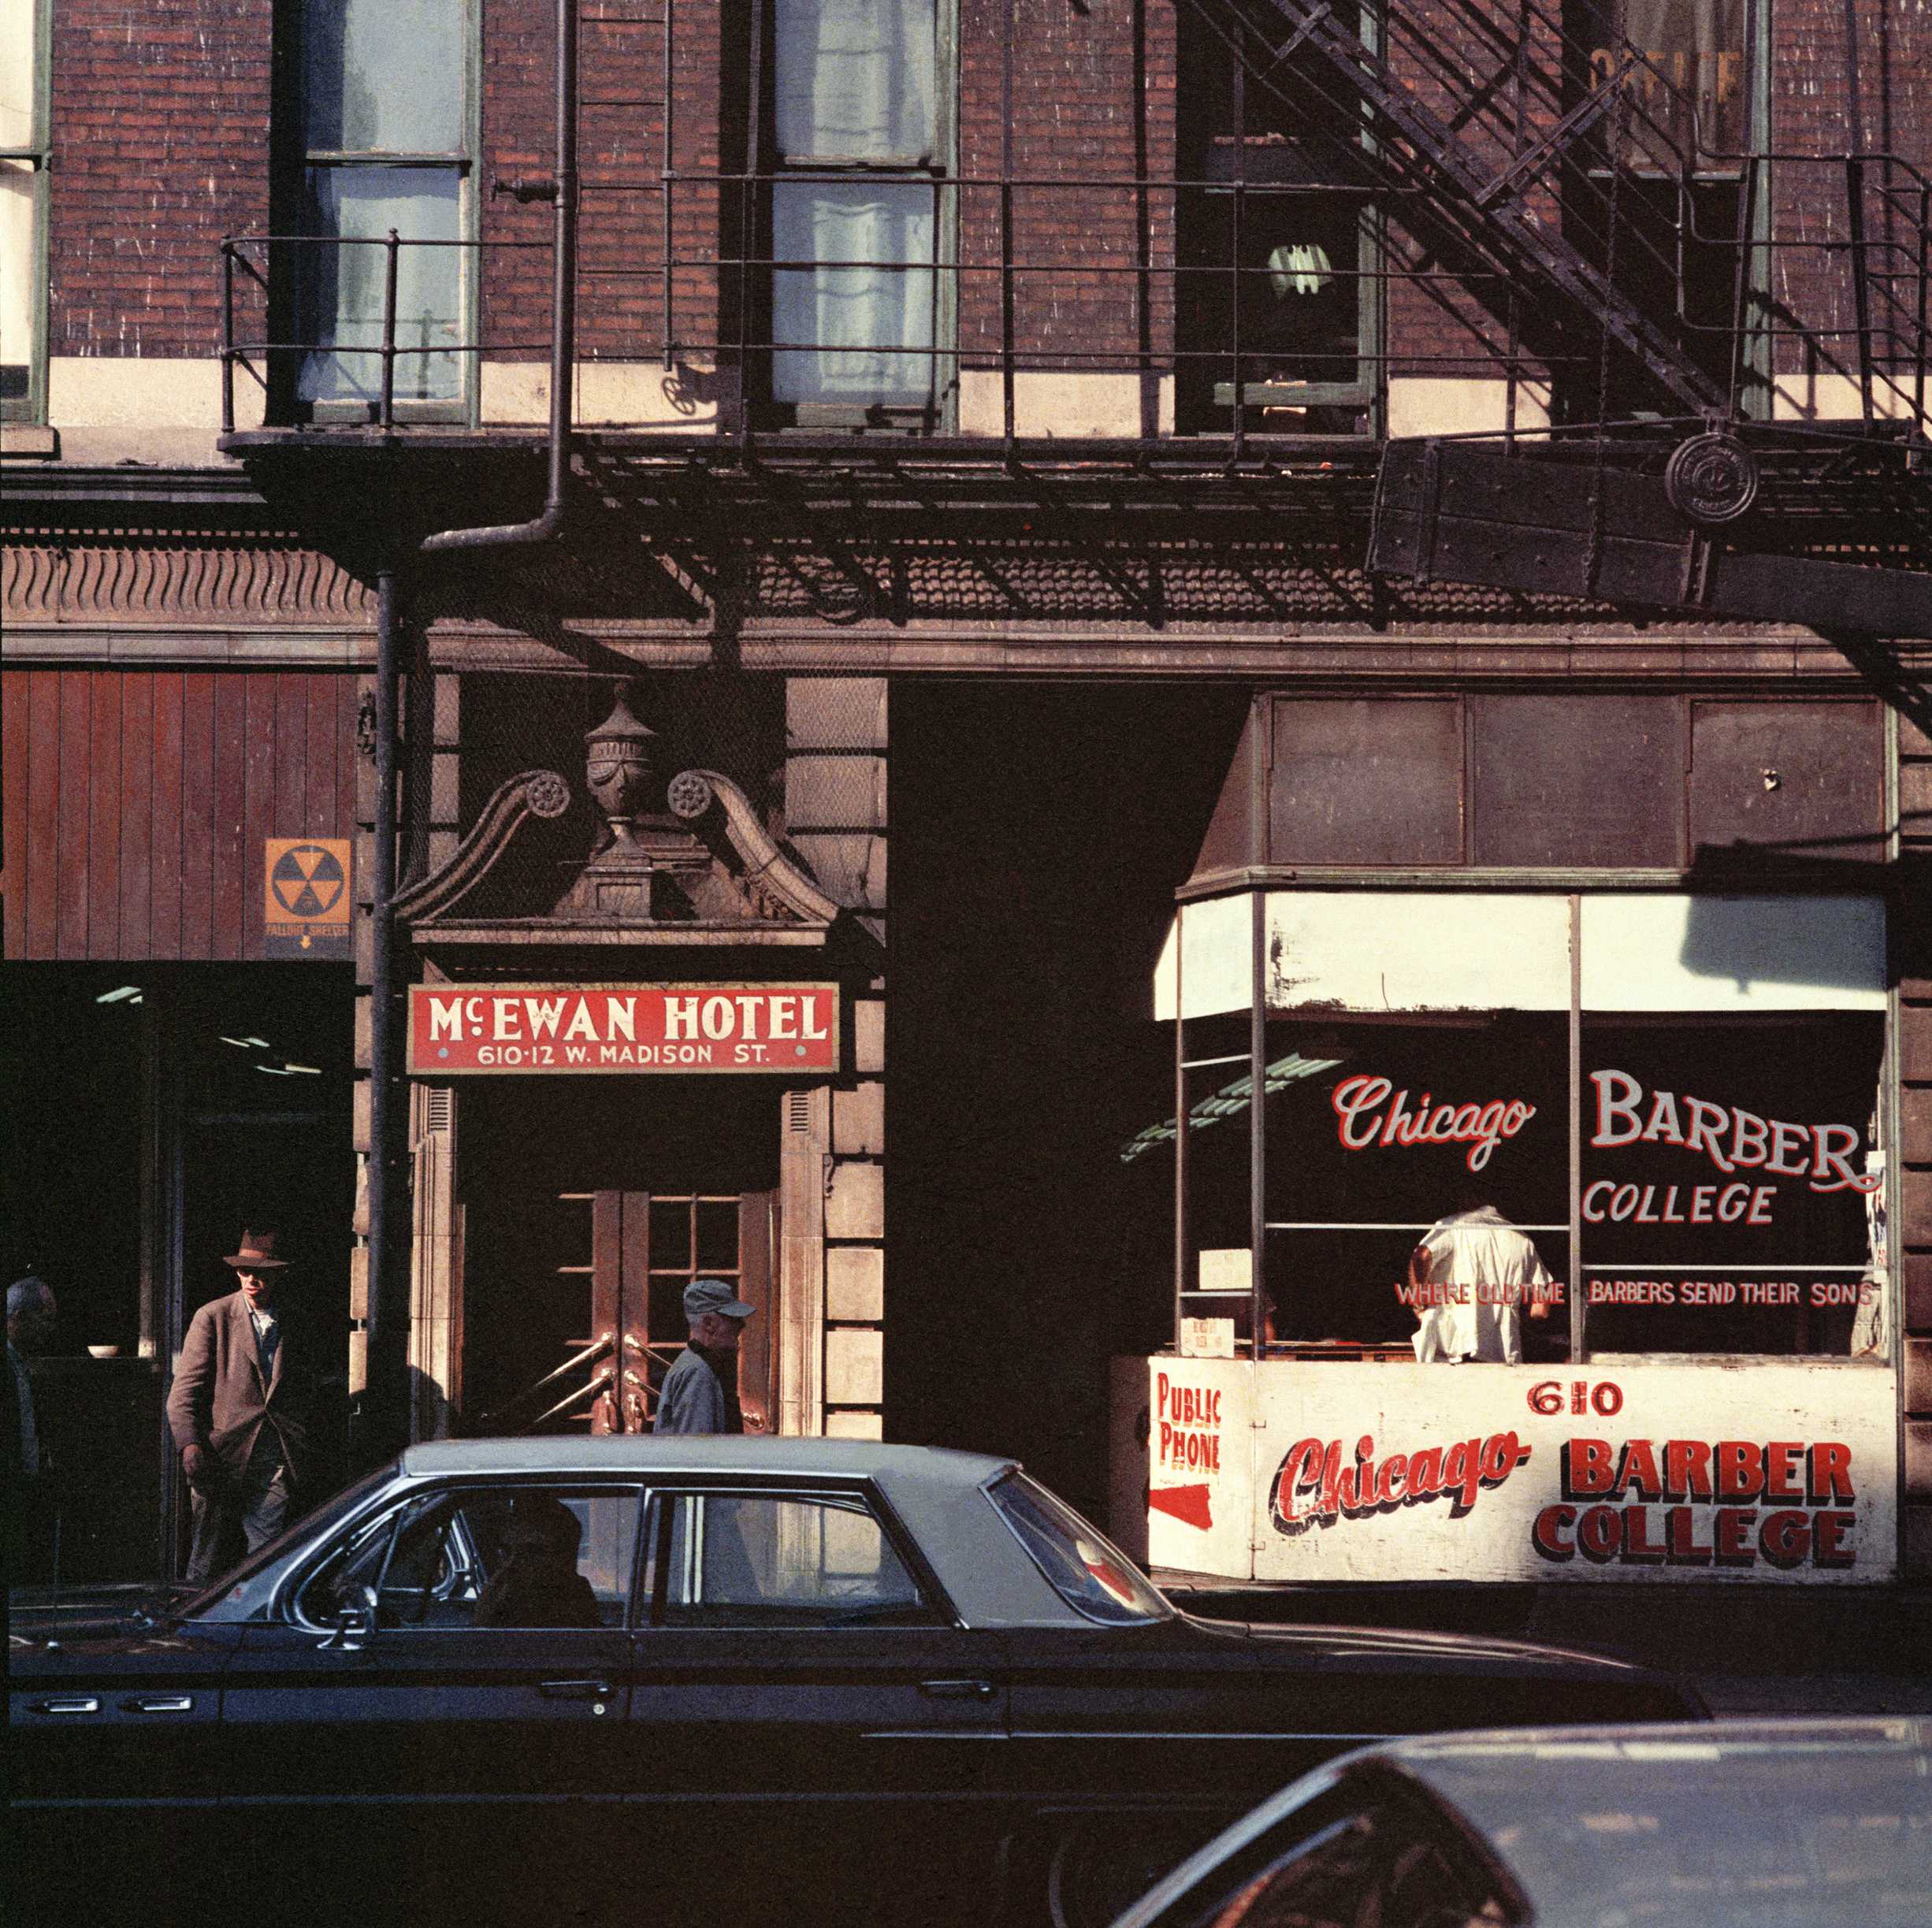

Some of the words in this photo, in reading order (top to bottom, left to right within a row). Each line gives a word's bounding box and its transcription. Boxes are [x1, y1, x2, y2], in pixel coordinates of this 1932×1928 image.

[266, 924, 306, 936] FALLOUT
[308, 924, 349, 936] SHELTER
[662, 995, 828, 1041] HOTEL
[565, 1046, 592, 1064] W.
[600, 1045, 712, 1064] MADISON
[734, 1044, 771, 1064] ST.
[1332, 1074, 1536, 1172] Chicago
[1588, 1068, 1882, 1194] BARBER
[1581, 1180, 1778, 1225] COLLEGE
[1394, 1282, 1471, 1306] WHERE
[1476, 1283, 1516, 1306] OLD
[1518, 1282, 1566, 1305] TIME
[1588, 1280, 1676, 1305] BARBERS
[1679, 1281, 1736, 1306] SEND
[1738, 1282, 1800, 1305] THEIR
[1810, 1281, 1874, 1306] SONS
[1157, 1371, 1222, 1430] PUBLIC
[1526, 1380, 1624, 1417] 610
[1159, 1421, 1221, 1476] PHONE
[1268, 1430, 1533, 1537] Chicago
[1559, 1437, 1856, 1508] BARBER
[1530, 1504, 1857, 1570] COLLEGE
